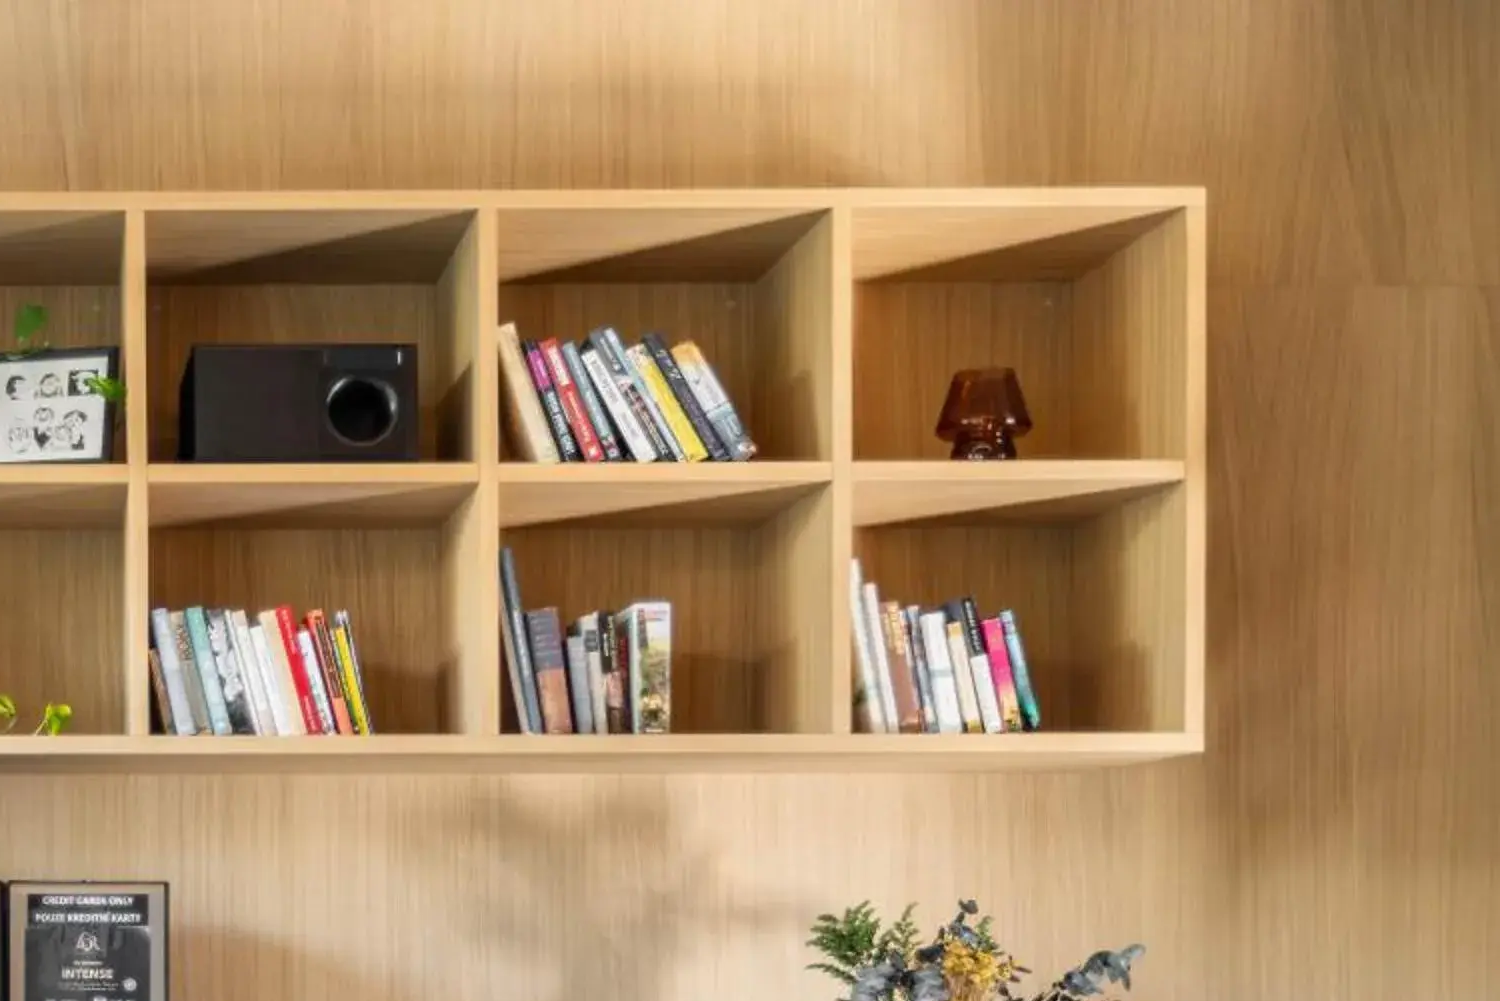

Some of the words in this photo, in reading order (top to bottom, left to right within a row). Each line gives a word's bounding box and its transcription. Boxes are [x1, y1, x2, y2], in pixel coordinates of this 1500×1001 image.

[41, 895, 75, 906] CREDIT
[108, 895, 134, 906] ONLY
[61, 968, 114, 979] INTENSE
